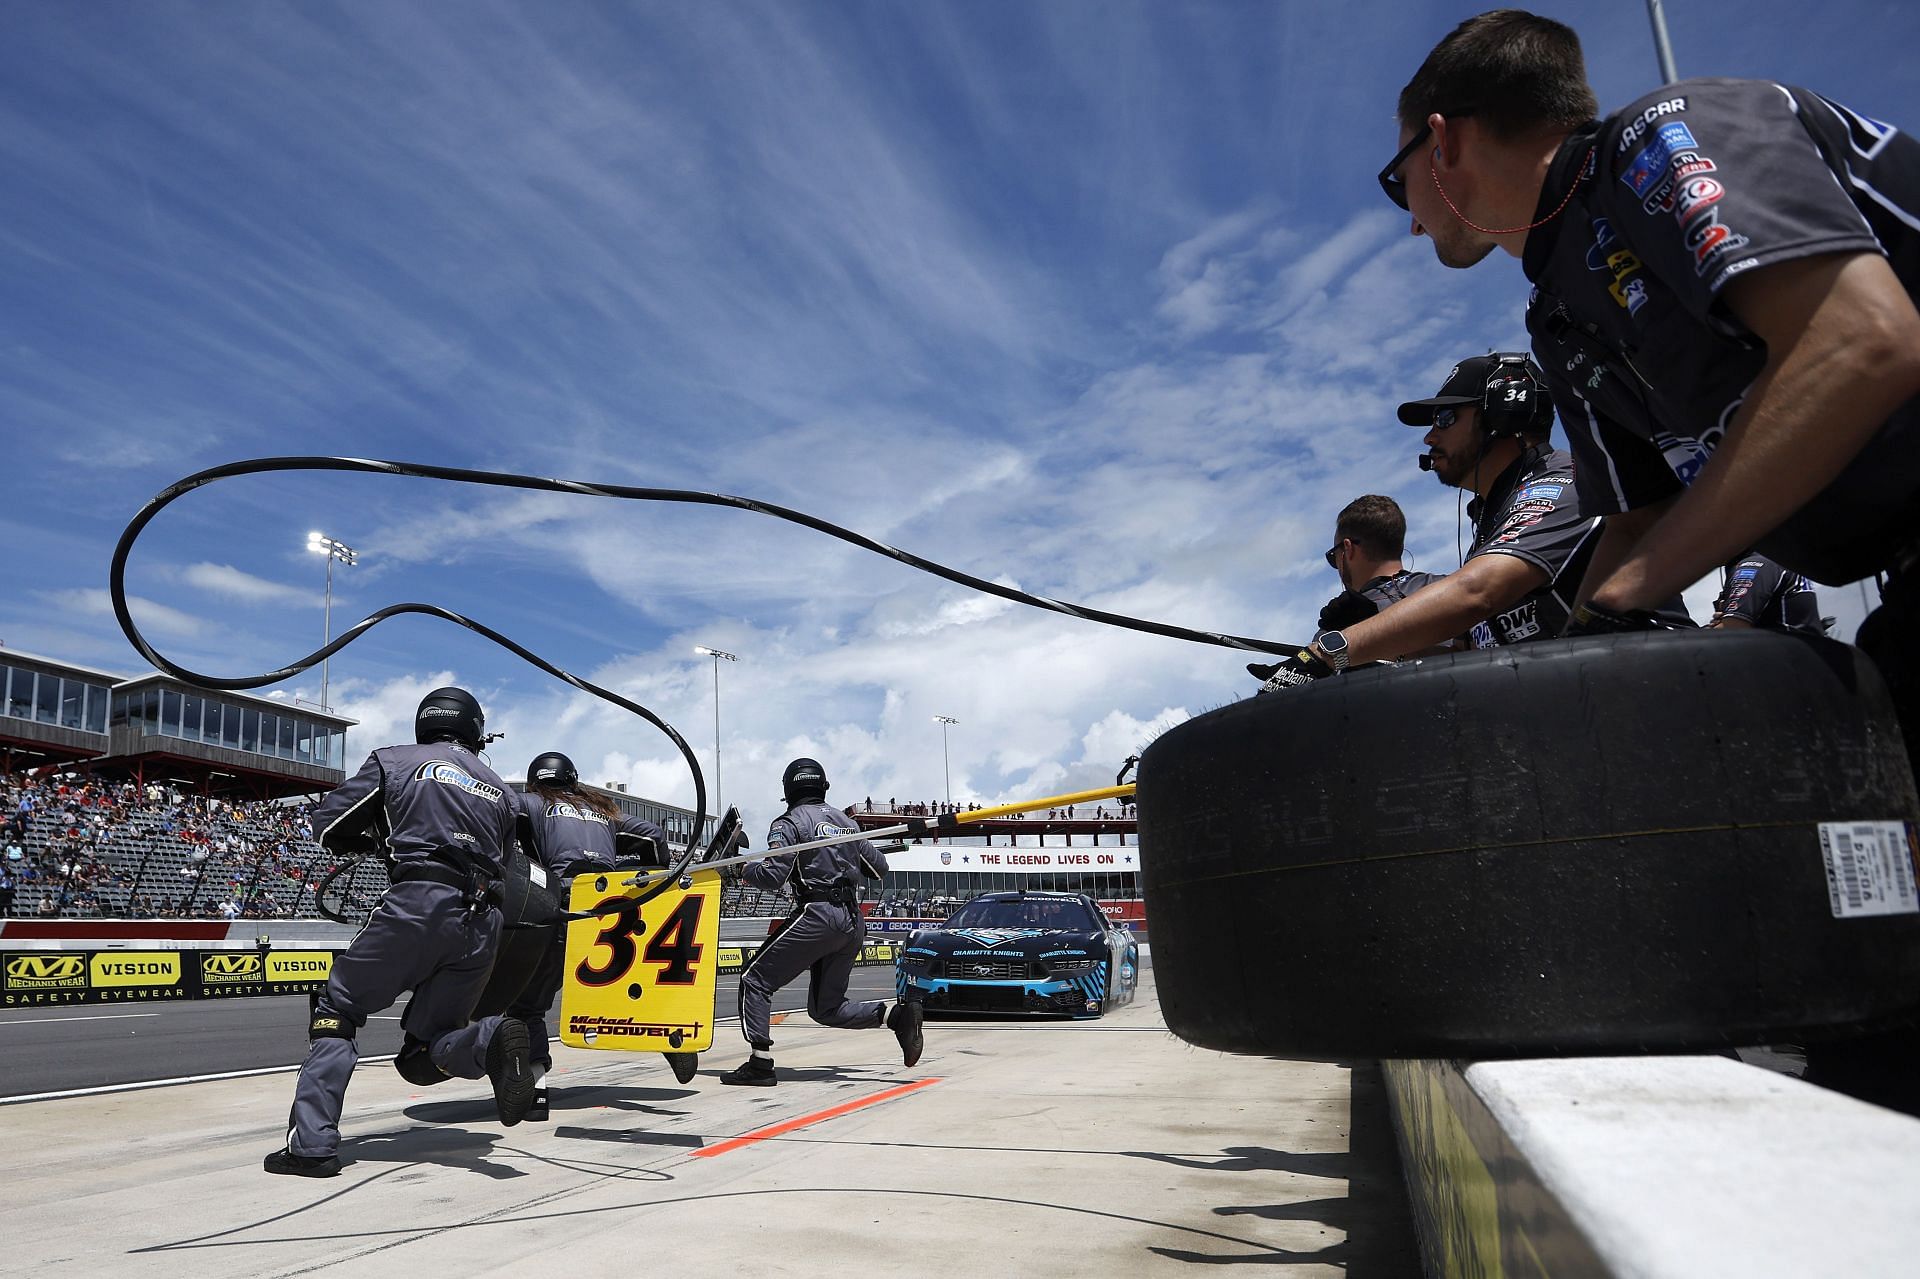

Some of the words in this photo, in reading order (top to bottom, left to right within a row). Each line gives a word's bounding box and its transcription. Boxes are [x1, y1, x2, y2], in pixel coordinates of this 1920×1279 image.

[1504, 389, 1527, 402] 34
[980, 854, 1001, 864] THE
[1006, 855, 1051, 865] LEGEND
[1057, 855, 1090, 865] LIVES
[1097, 854, 1114, 864] ON
[888, 922, 913, 930] GEICO
[574, 893, 706, 988] 34
[101, 963, 173, 975] VISION
[273, 961, 327, 972] VISION
[8, 977, 57, 989] MECHANIX
[58, 976, 86, 987] WEAR
[204, 973, 241, 982] MECHANIX
[241, 972, 262, 981] WEAR
[907, 974, 918, 986] 34
[203, 986, 262, 996] SAFETY
[273, 984, 326, 993] EYEWE
[5, 992, 86, 1004] SAFETY
[101, 989, 184, 999] EYEWEAR
[569, 1015, 634, 1025] Michael
